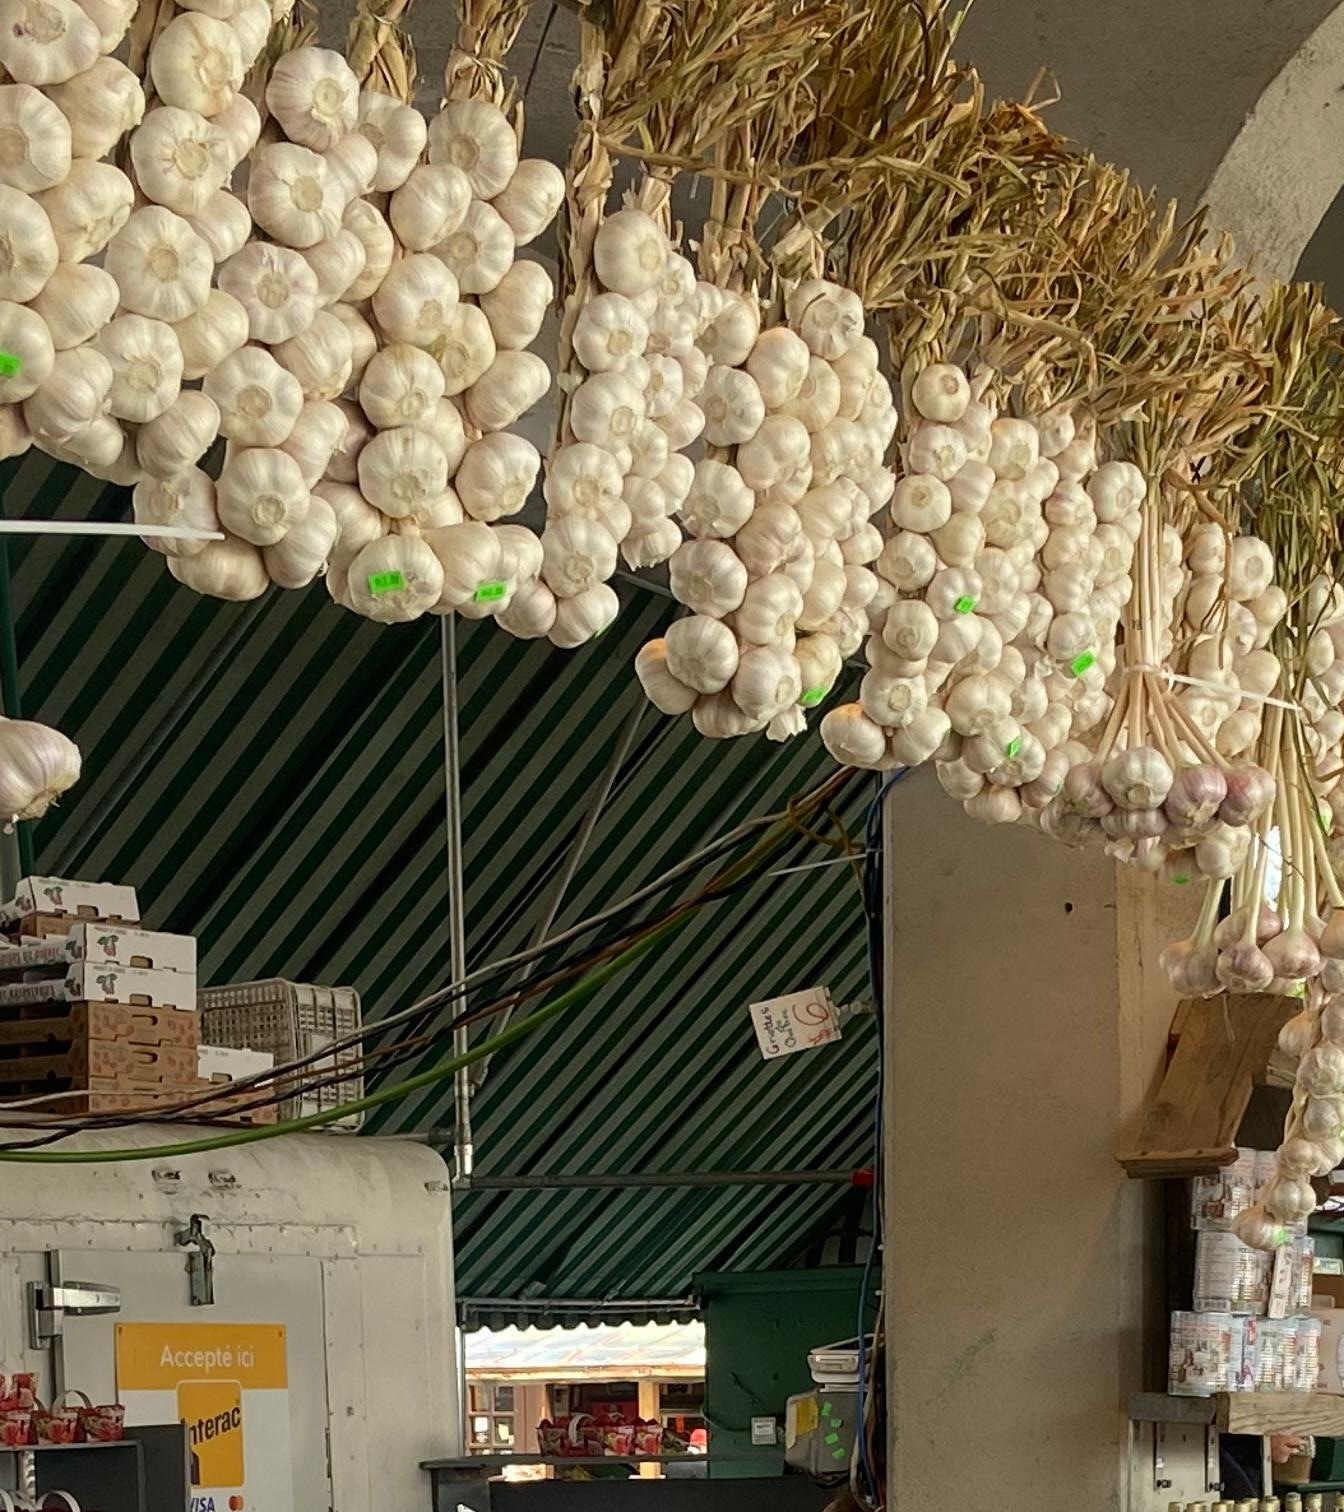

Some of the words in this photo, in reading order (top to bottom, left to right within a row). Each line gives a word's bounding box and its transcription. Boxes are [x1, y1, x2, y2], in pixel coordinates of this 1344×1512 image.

[160, 1344, 232, 1374] Accepté
[237, 1345, 255, 1368] ici
[181, 1405, 242, 1446] nterac
